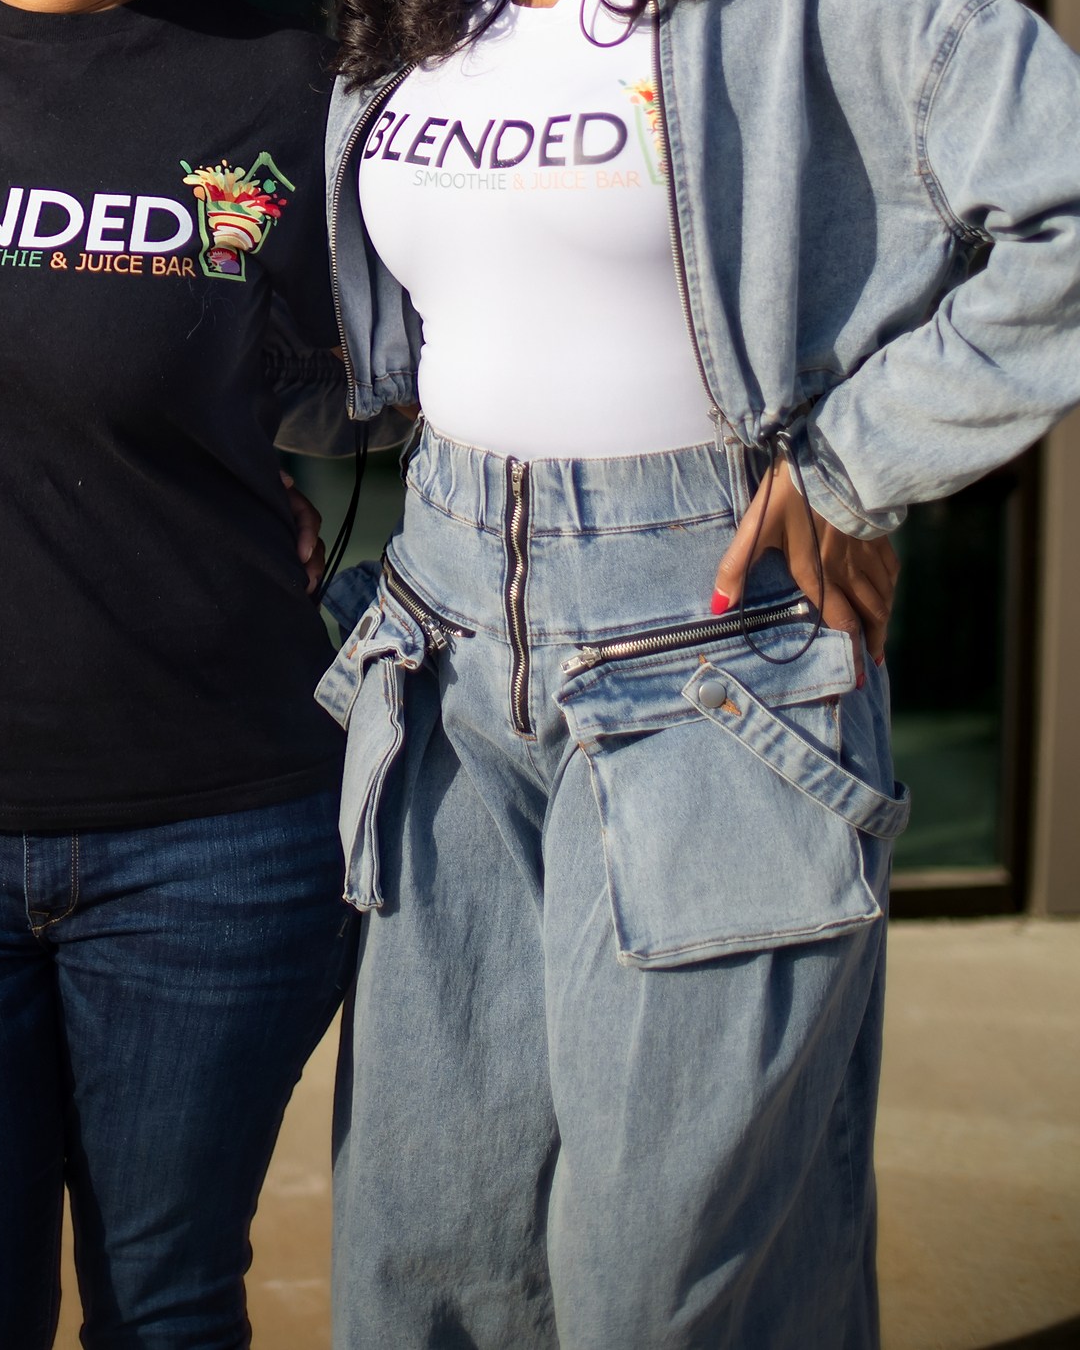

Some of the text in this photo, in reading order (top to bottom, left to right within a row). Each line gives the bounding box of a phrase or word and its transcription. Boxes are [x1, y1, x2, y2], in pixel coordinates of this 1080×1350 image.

[363, 111, 628, 169] BLENDED
[413, 170, 642, 190] SMOOTHIE & JUICE BAR
[50, 251, 68, 270] &
[75, 253, 144, 274] JUICE
[151, 256, 197, 278] BAR
